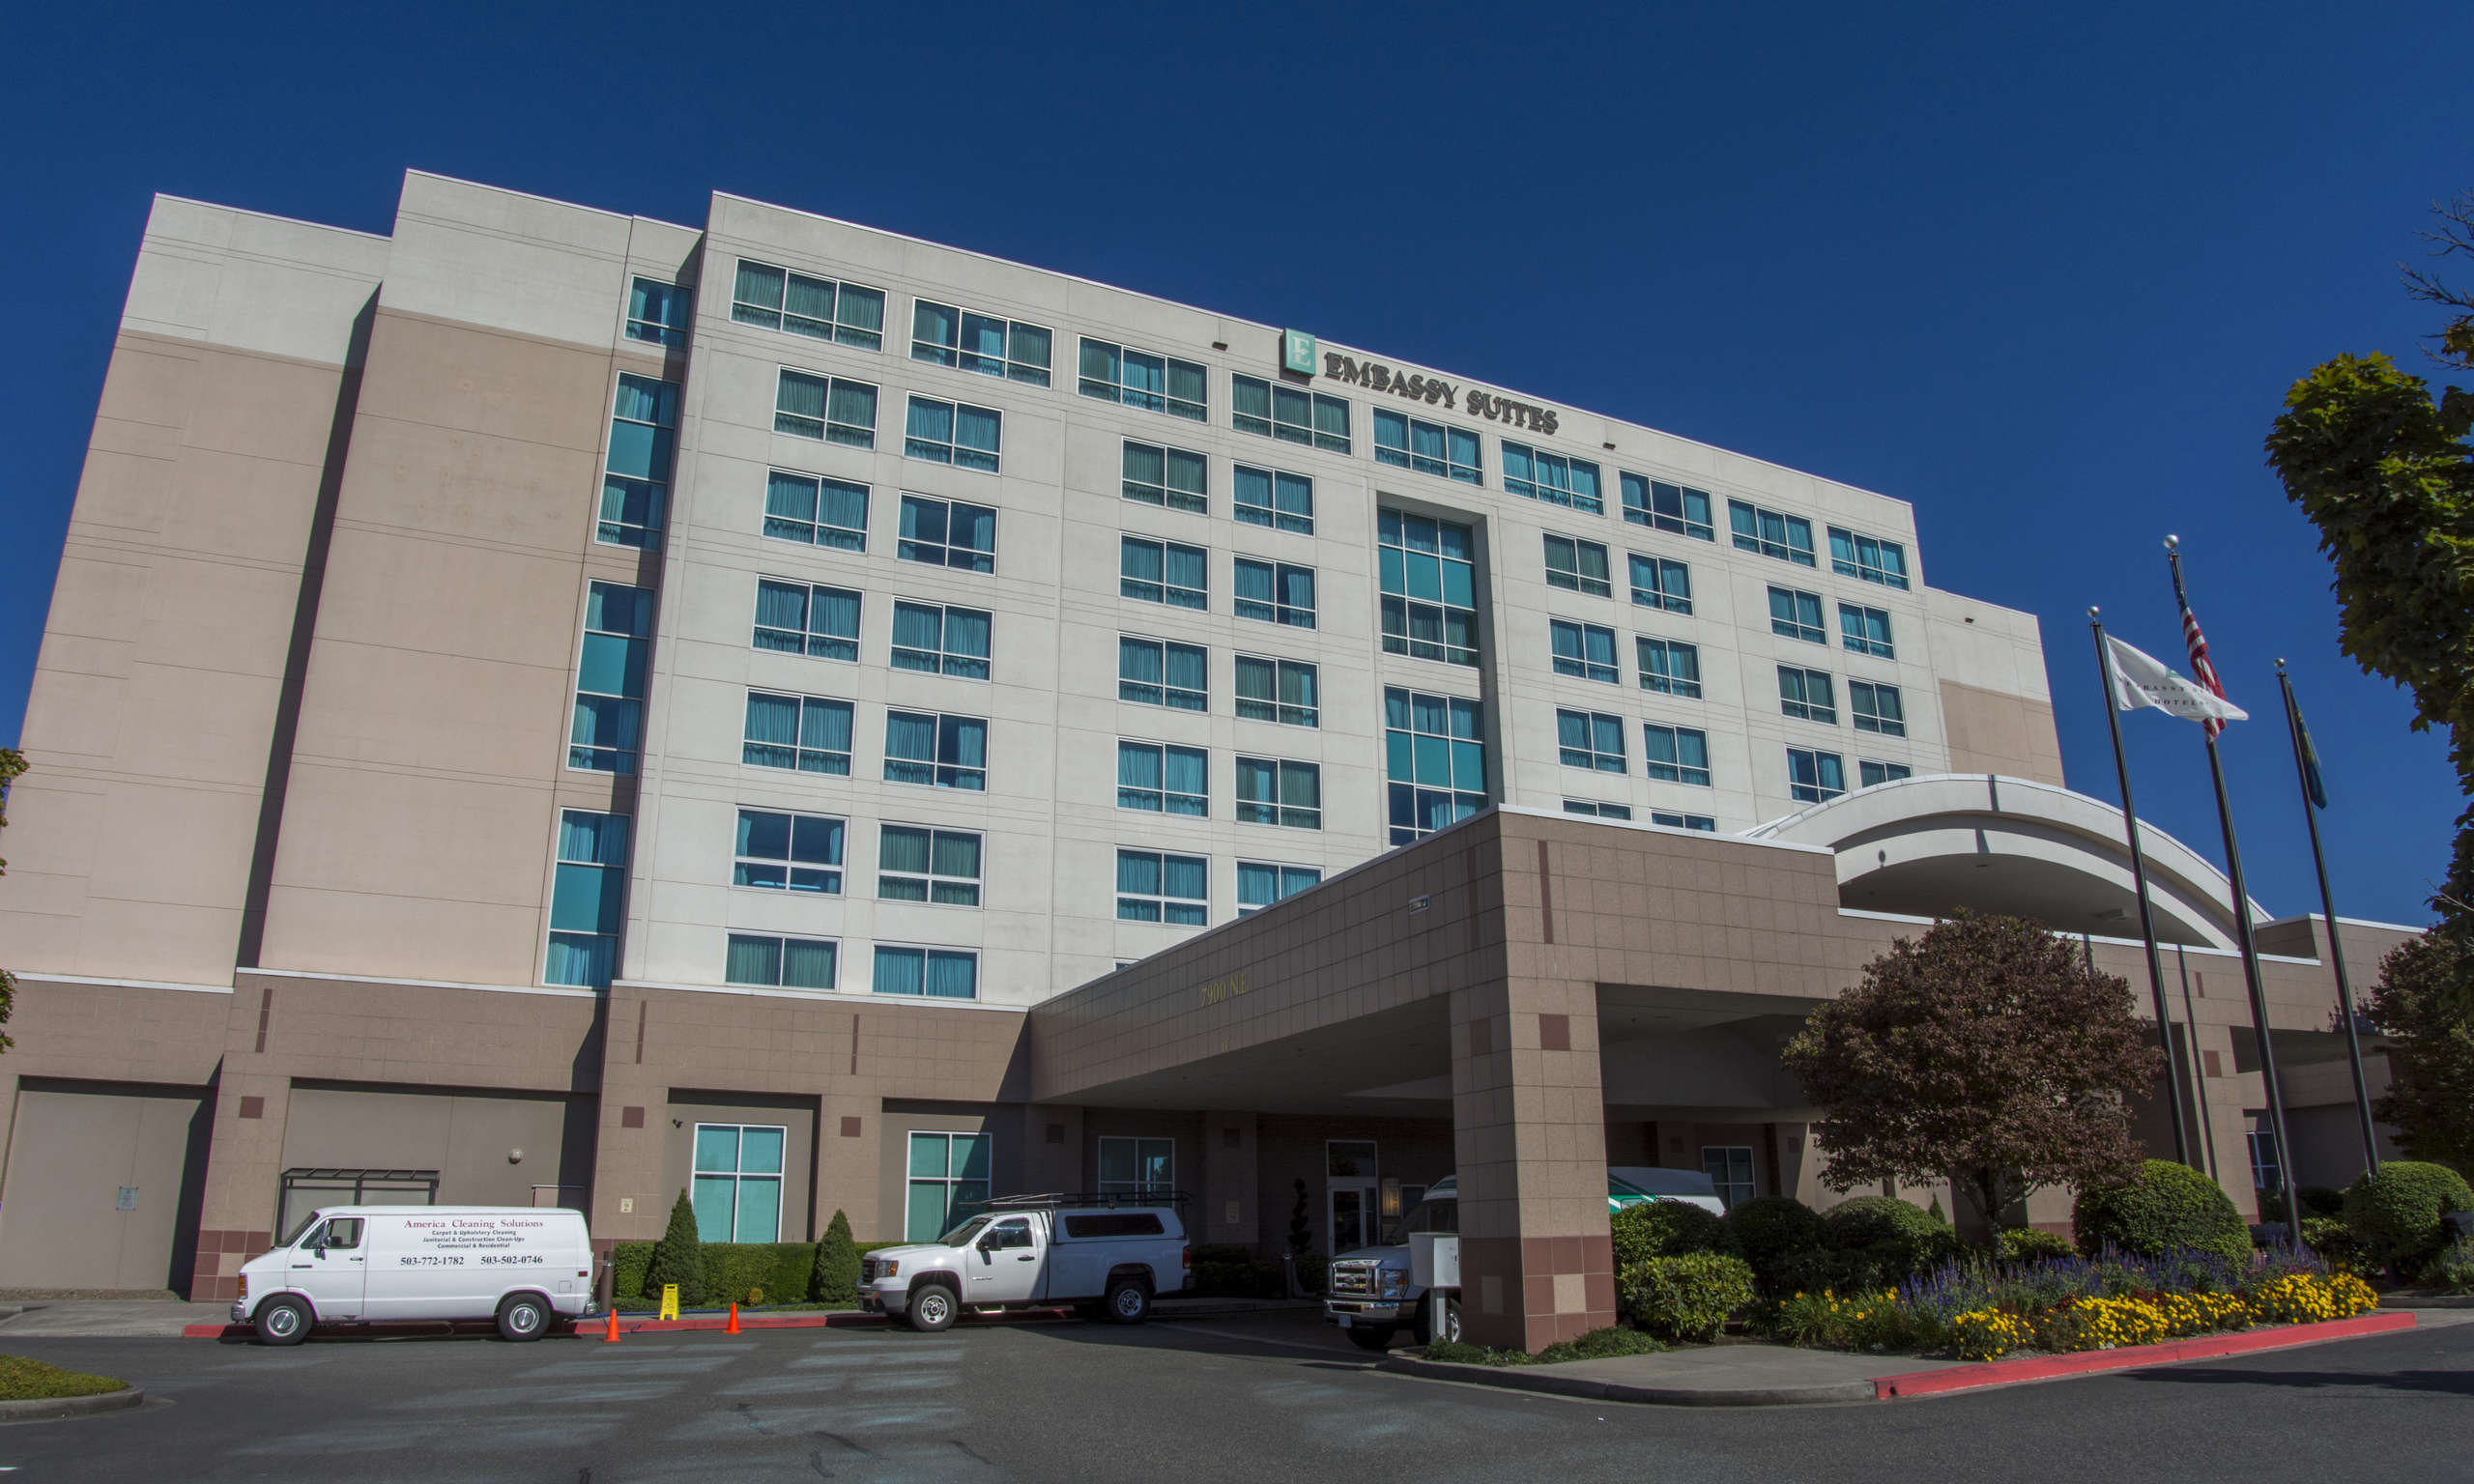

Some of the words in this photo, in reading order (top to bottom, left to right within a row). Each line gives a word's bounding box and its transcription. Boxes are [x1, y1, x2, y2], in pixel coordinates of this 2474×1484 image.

[1324, 352, 1459, 410] EMBASSY
[1466, 389, 1559, 435] SUITES
[404, 1219, 446, 1229] America
[451, 1218, 495, 1229] Cleaning
[501, 1218, 543, 1228] Solutions
[400, 1257, 464, 1266] 503-772-1782
[480, 1256, 543, 1265] 503-502-0746
